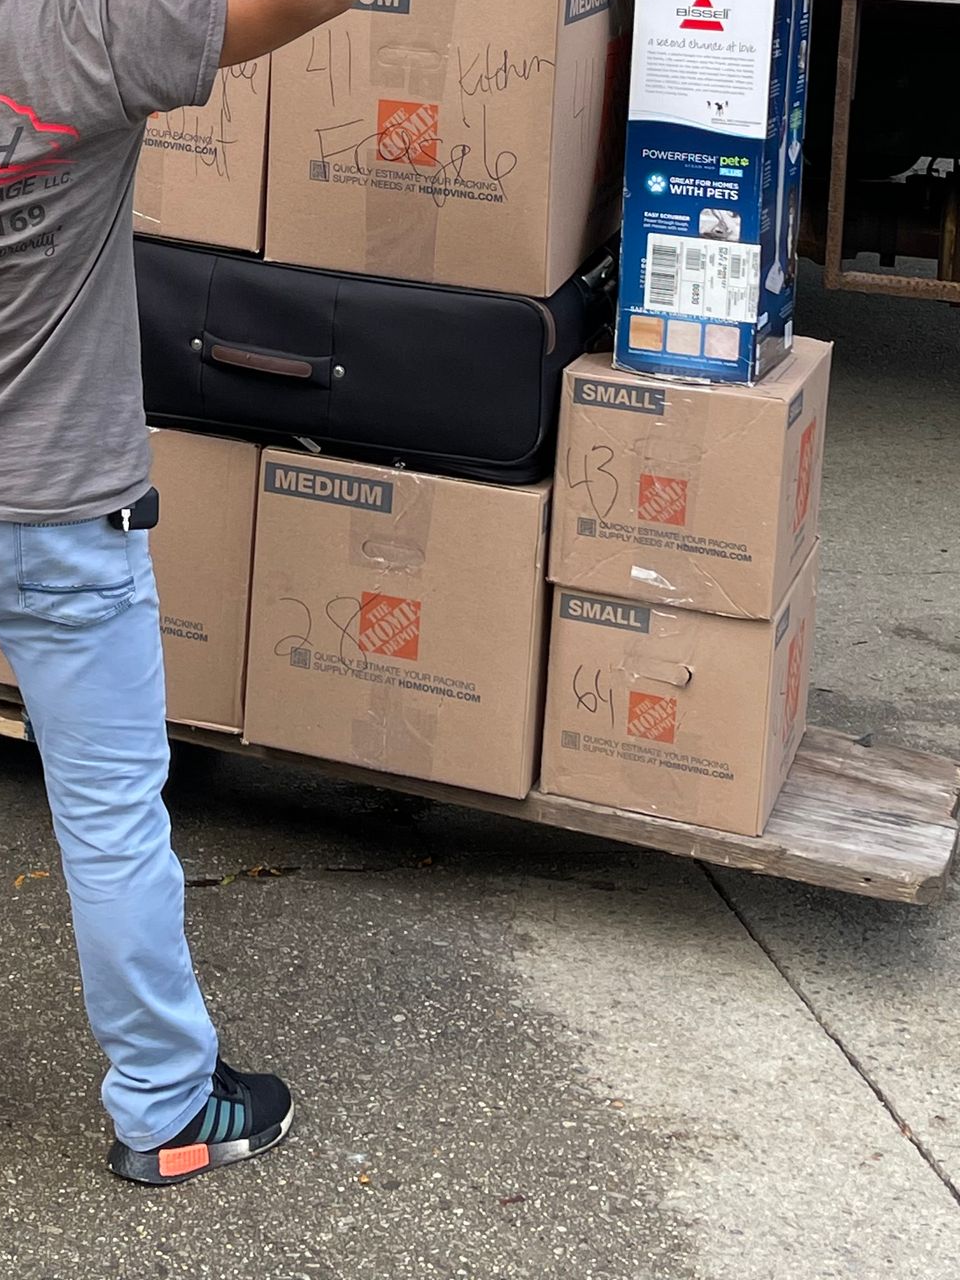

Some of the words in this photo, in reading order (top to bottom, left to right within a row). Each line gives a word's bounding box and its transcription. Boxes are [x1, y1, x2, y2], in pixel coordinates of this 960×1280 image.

[688, 39, 724, 51] chance
[379, 104, 438, 159] HOME
[720, 156, 740, 167] pet
[332, 163, 372, 176] QUICKLY
[375, 169, 422, 182] ESTIMATE
[424, 175, 452, 186] YOUR
[453, 178, 497, 192] PACKING
[332, 175, 369, 187] SUPPLY
[371, 180, 403, 192] NEEDS
[404, 184, 415, 193] AT
[418, 186, 503, 203] HDMOVING.COM
[670, 176, 694, 185] GREAT
[712, 181, 739, 190] HOMES
[670, 184, 703, 198] WITH
[707, 188, 739, 200] PETS
[582, 383, 656, 409] SMALL
[274, 469, 383, 507] MEDIUM
[598, 530, 632, 543] SUPPLY
[633, 536, 662, 548] NEEDS
[664, 541, 675, 549] AT
[676, 543, 752, 562] HDMOVING.COM
[599, 521, 636, 534] QUICKLY
[637, 527, 680, 540] ESTIMATE
[681, 533, 707, 545] YOUR
[707, 538, 747, 552] PACKING
[164, 616, 203, 631] PACKING
[359, 600, 420, 652] HOME
[367, 601, 390, 623] THE
[568, 598, 641, 628] SMALL
[382, 624, 419, 656] DEPOT
[313, 651, 354, 667] QUICKLY
[356, 660, 401, 676] ESTIMATE
[404, 669, 431, 682] YOUR
[433, 675, 476, 691] PACKING
[313, 662, 349, 677] SUPPLY
[351, 669, 383, 683] NEEDS
[384, 676, 397, 686] AT
[398, 679, 481, 703] HDMOVING.COM
[628, 696, 677, 735] HOME
[582, 745, 615, 758] SUPPLY
[617, 751, 645, 763] NEEDS
[647, 757, 658, 766] AT
[659, 759, 734, 781] HDMOVING.COM
[583, 734, 619, 748] QUICKLY
[621, 742, 661, 757] ESTIMATE
[663, 751, 690, 763] YOUR
[690, 757, 729, 771] PACKING
